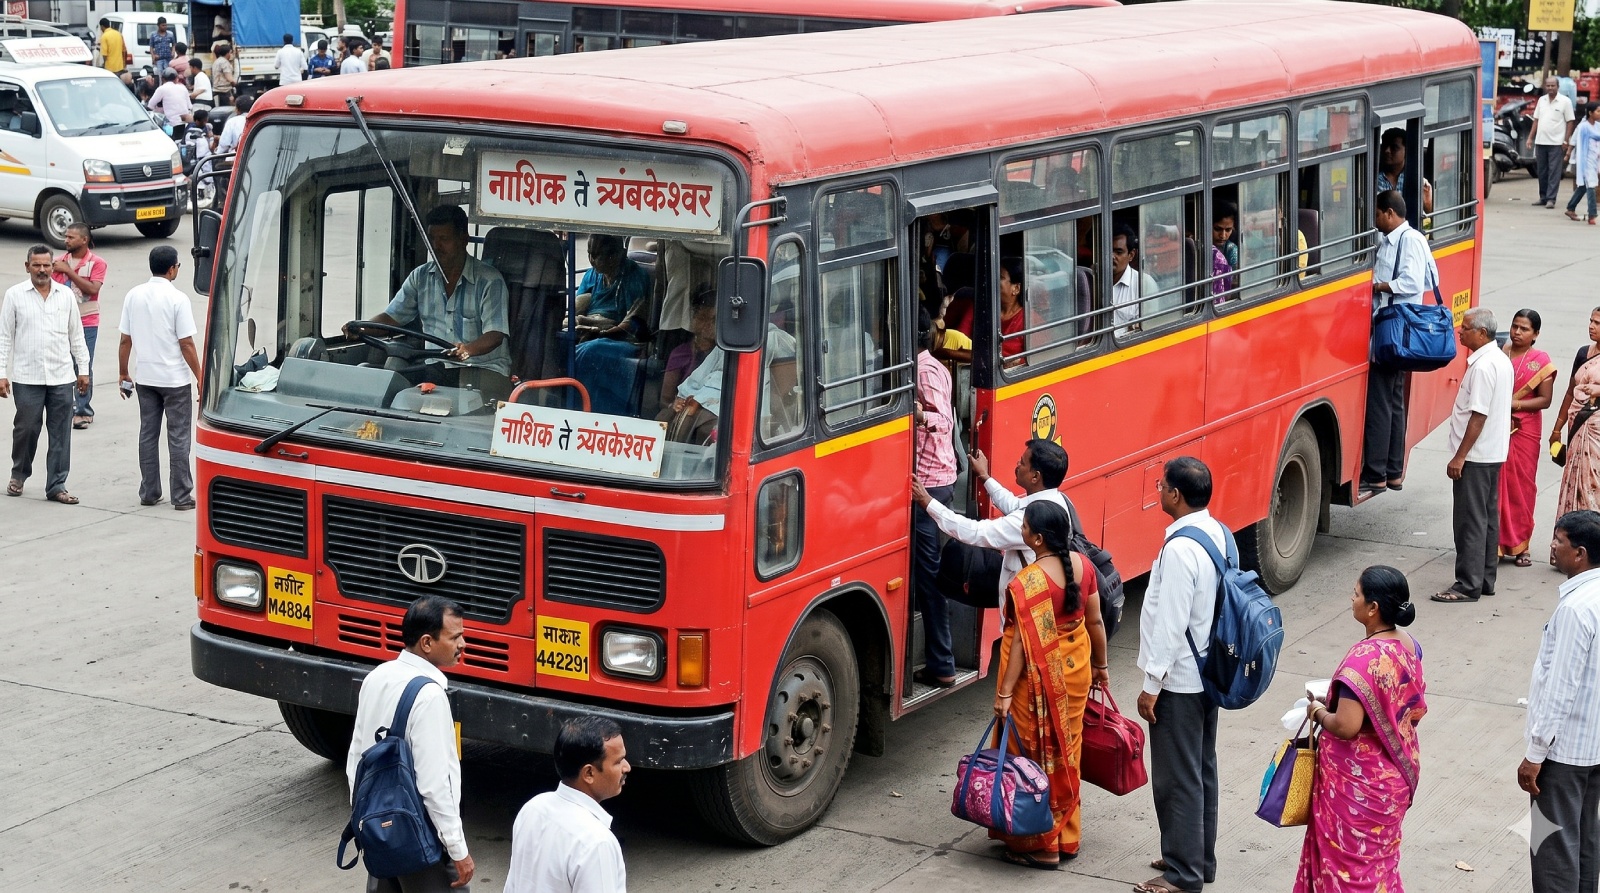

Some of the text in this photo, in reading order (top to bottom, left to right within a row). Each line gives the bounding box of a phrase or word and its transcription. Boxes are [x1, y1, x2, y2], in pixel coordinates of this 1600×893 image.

[488, 159, 713, 218] नाशिक ते त्र्यंबकेश्वर
[501, 411, 657, 462] नाशिक ते त्र्यंबकेश्वर
[268, 597, 312, 622] M4884
[536, 649, 589, 675] 442291
